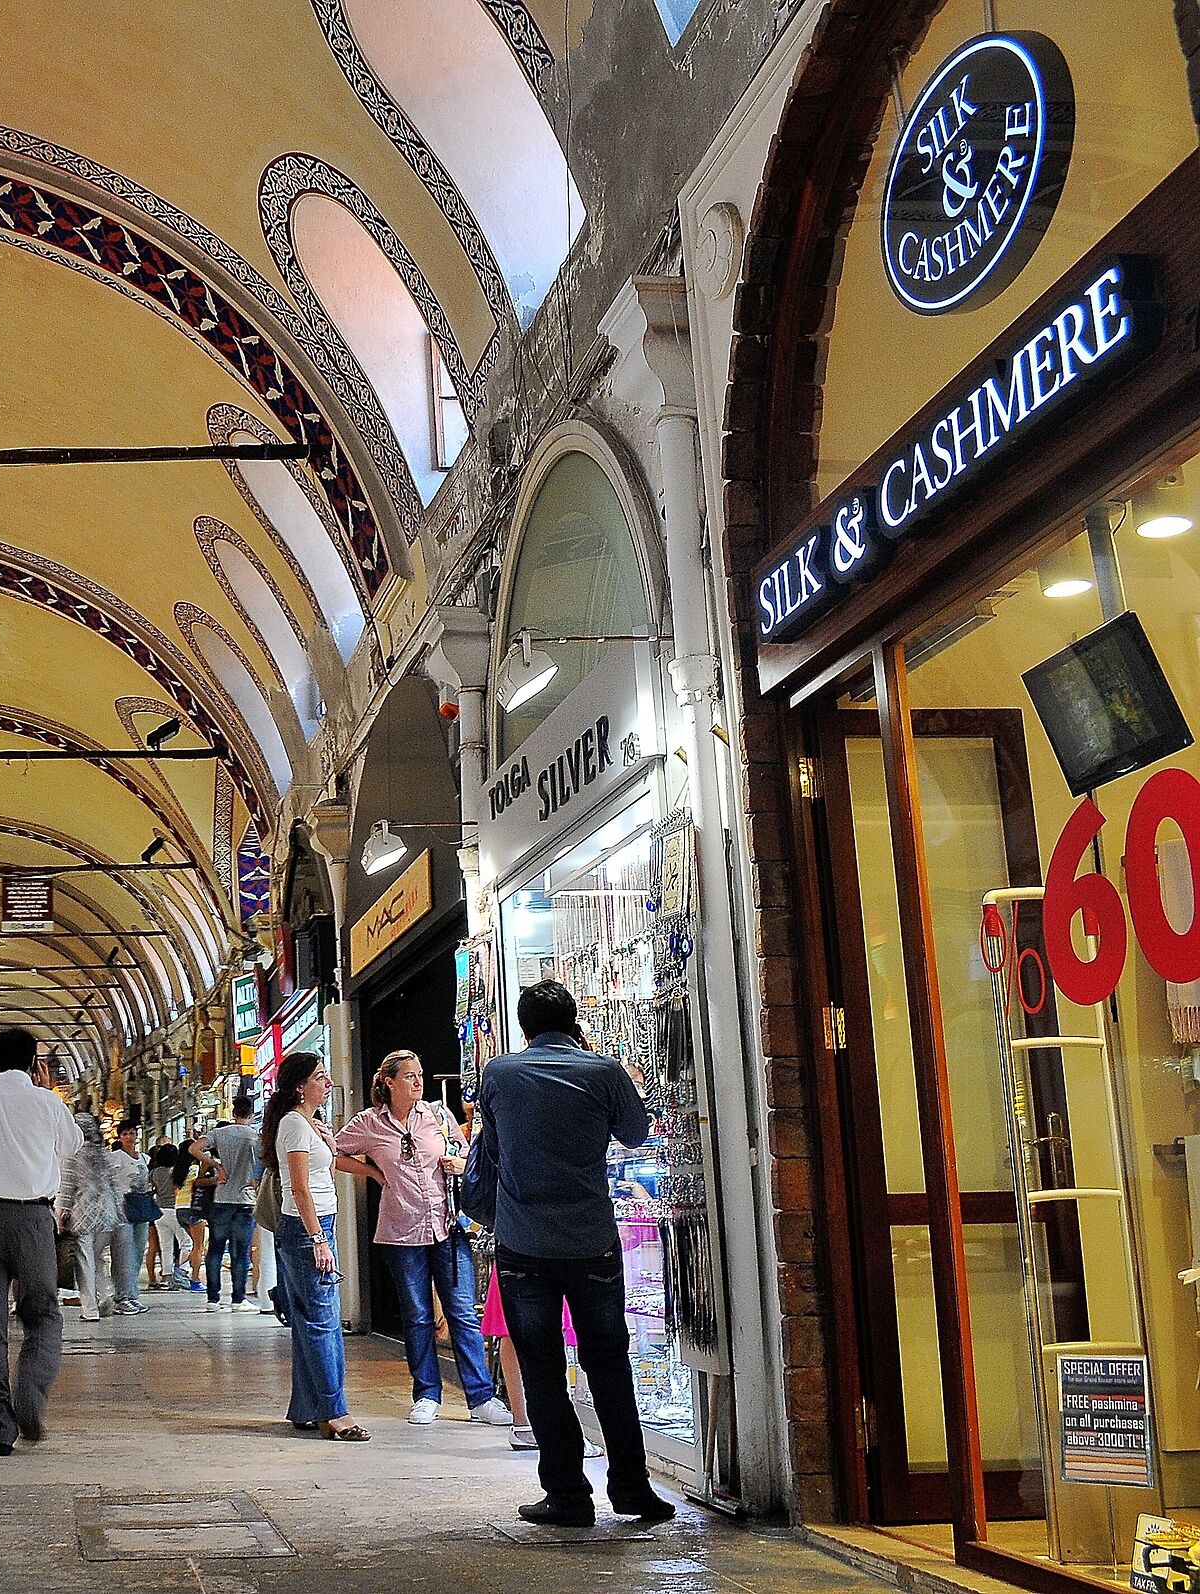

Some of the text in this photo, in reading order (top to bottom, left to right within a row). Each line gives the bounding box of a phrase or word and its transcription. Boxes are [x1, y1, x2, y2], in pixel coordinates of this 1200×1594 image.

[916, 74, 978, 174] SILK
[898, 102, 1032, 282] CASHMERE
[942, 145, 979, 218] &
[759, 266, 1132, 635] SILK & CASHMERE
[488, 755, 531, 820] TOLGA
[537, 714, 615, 821] SILVER
[1063, 1361, 1141, 1376] SPECIAL OFFER
[1065, 1413, 1144, 1430] on all purchases
[1066, 1395, 1138, 1411] FREE pashmina
[1067, 1432, 1096, 1446] above
[1098, 1433, 1125, 1447] 3000
[1133, 1576, 1146, 1588] TAX
